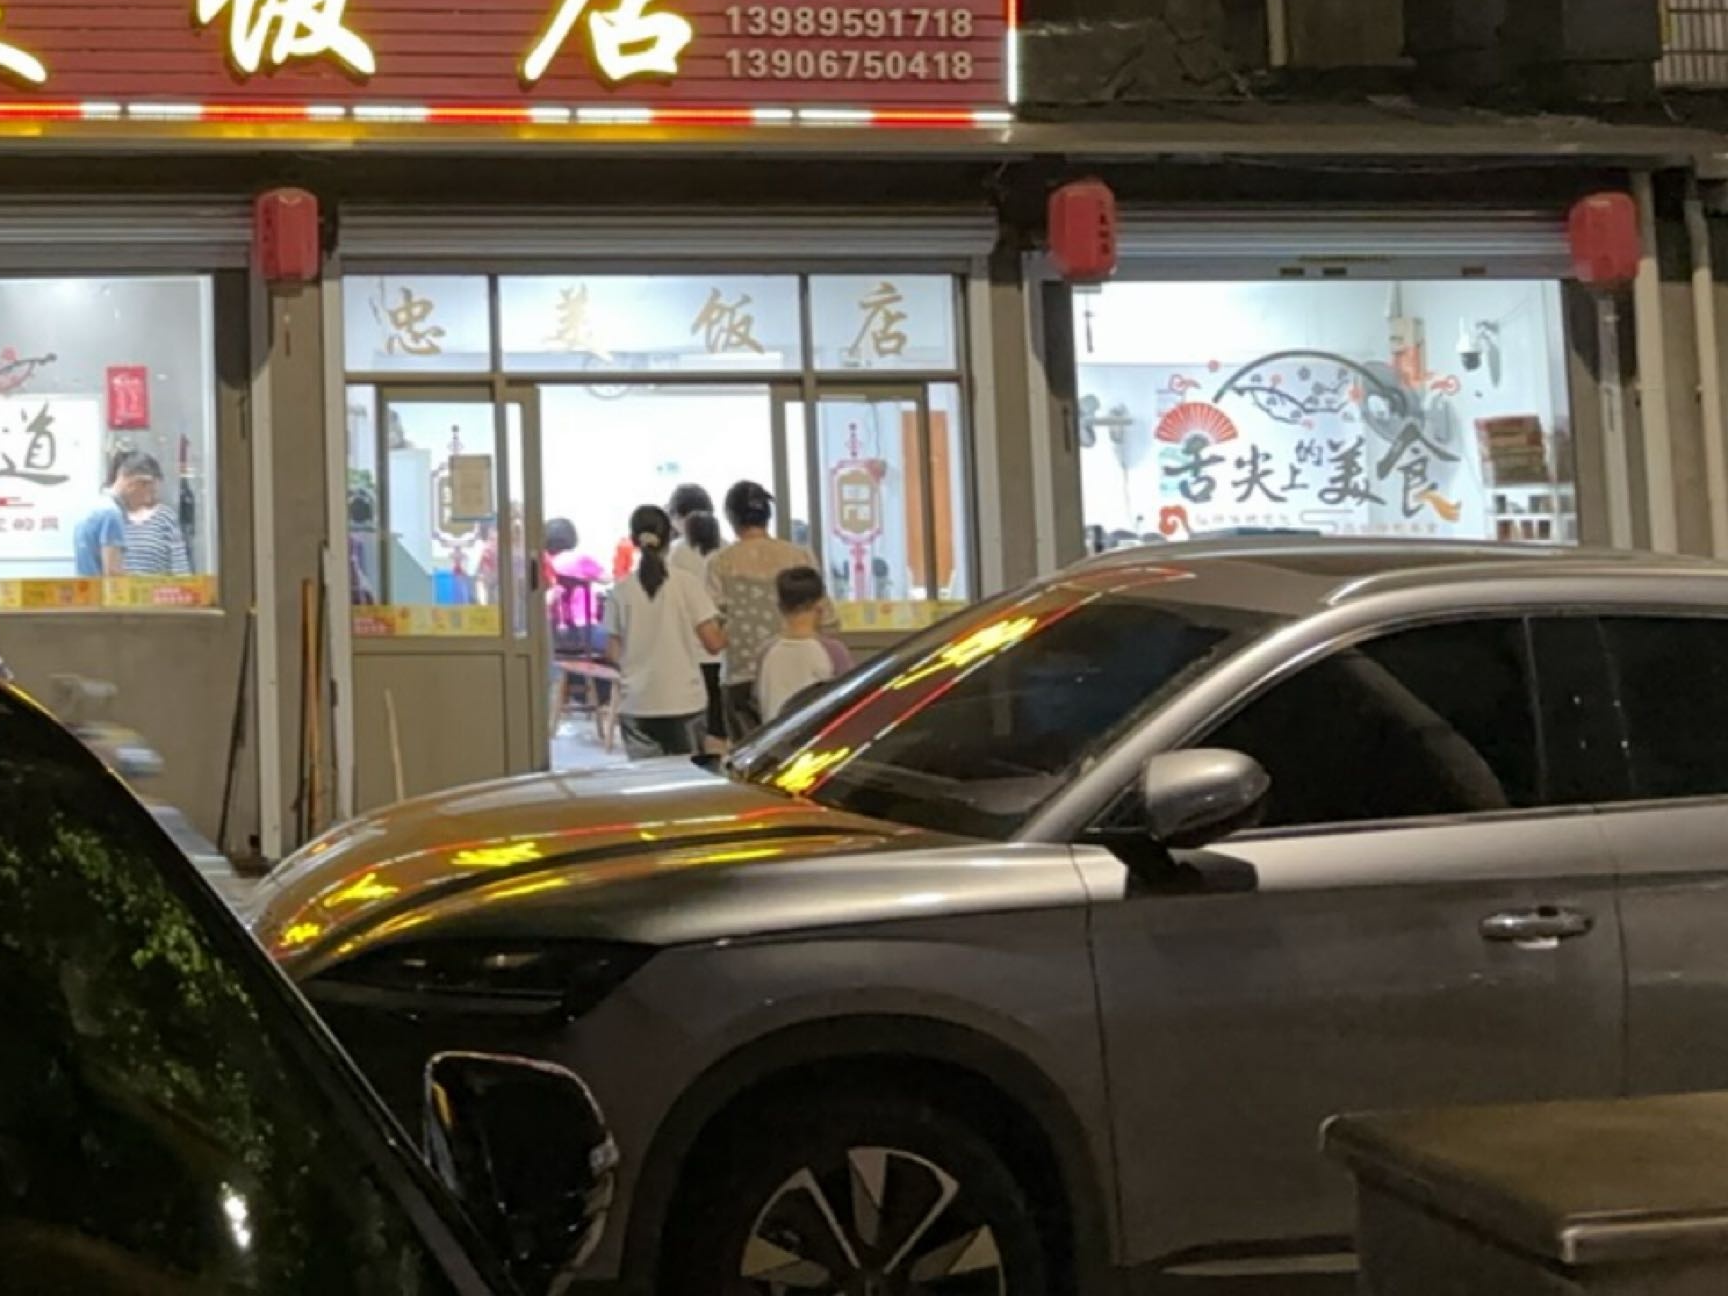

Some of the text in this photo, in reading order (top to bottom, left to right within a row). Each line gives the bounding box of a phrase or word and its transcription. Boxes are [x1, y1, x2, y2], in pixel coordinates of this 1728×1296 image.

[725, 5, 973, 38] 13989591718
[725, 48, 973, 80] 13906750418
[385, 281, 911, 360] 忠美饭店
